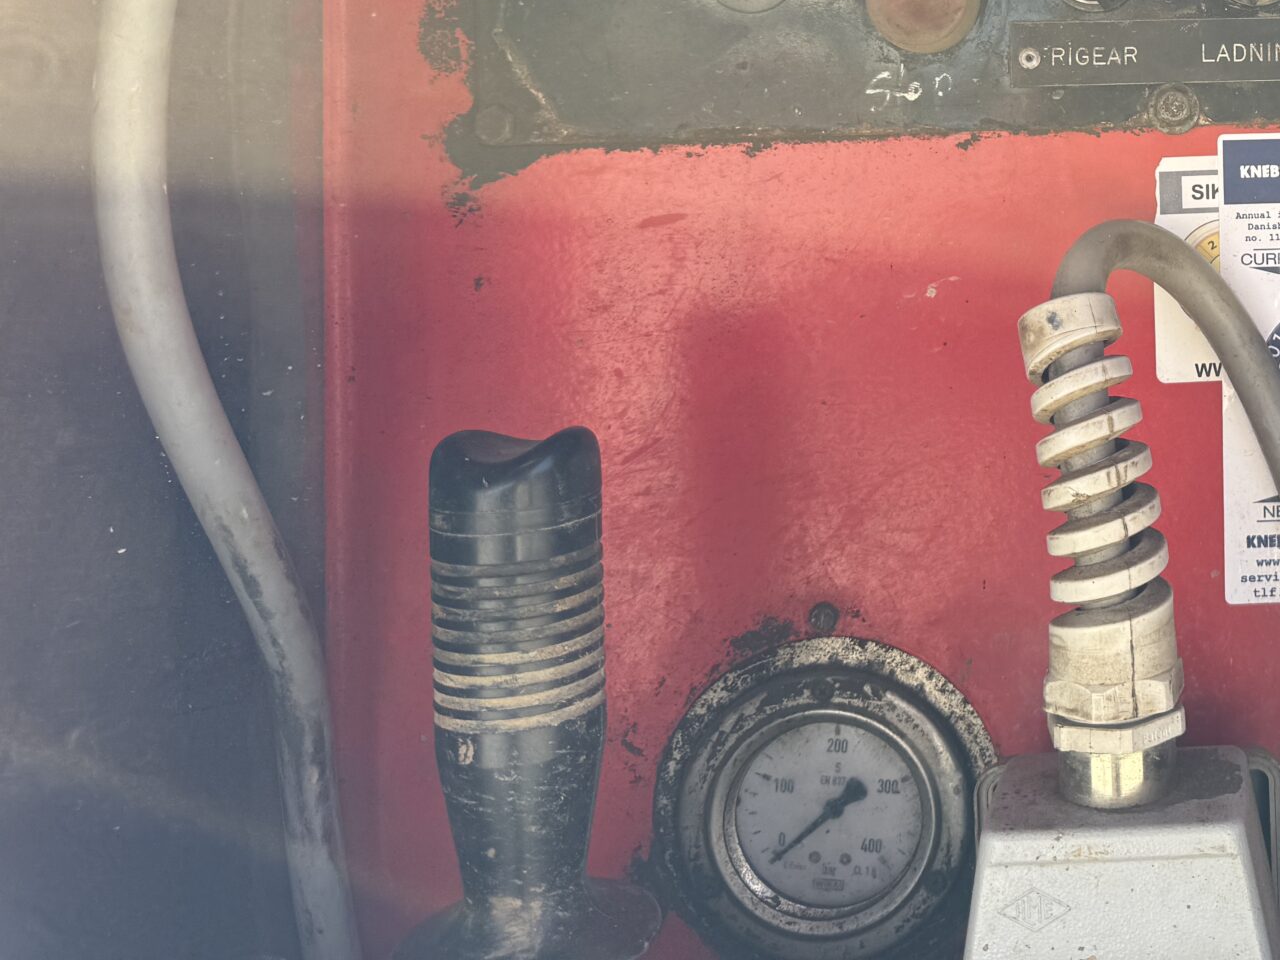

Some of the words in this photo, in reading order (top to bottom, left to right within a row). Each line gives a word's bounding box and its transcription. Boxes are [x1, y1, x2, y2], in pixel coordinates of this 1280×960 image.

[1236, 211, 1271, 220] Annual
[1245, 234, 1262, 242] no.
[826, 739, 848, 754] 200
[774, 778, 794, 794] 100
[877, 779, 899, 794] 300
[779, 832, 786, 847] 0
[860, 838, 882, 853] 400
